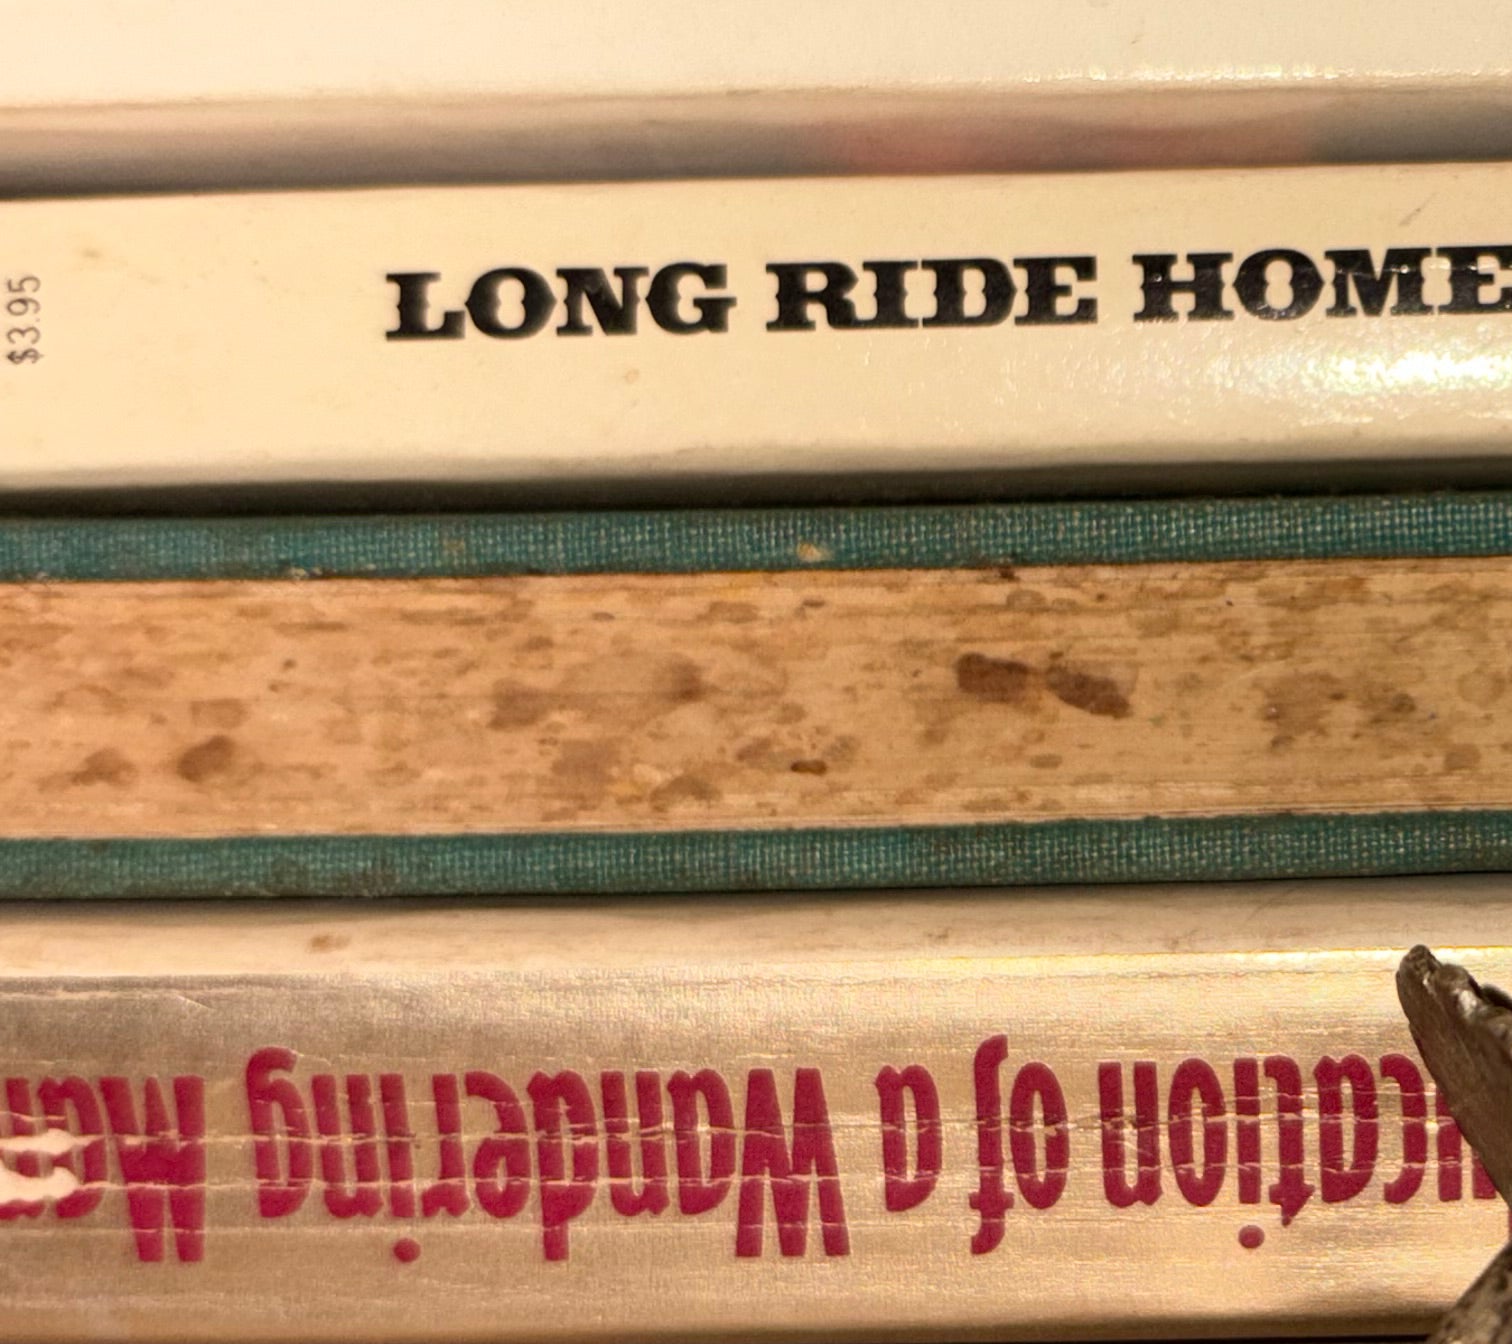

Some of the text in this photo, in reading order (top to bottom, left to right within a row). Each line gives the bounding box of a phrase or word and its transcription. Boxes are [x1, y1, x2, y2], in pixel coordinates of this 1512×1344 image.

[6, 274, 45, 366] $3.95
[385, 262, 738, 341] LONG
[765, 254, 1100, 333] RIDE
[246, 1046, 852, 1262] Wandering
[873, 1063, 944, 1213] a
[968, 1033, 1070, 1256] of
